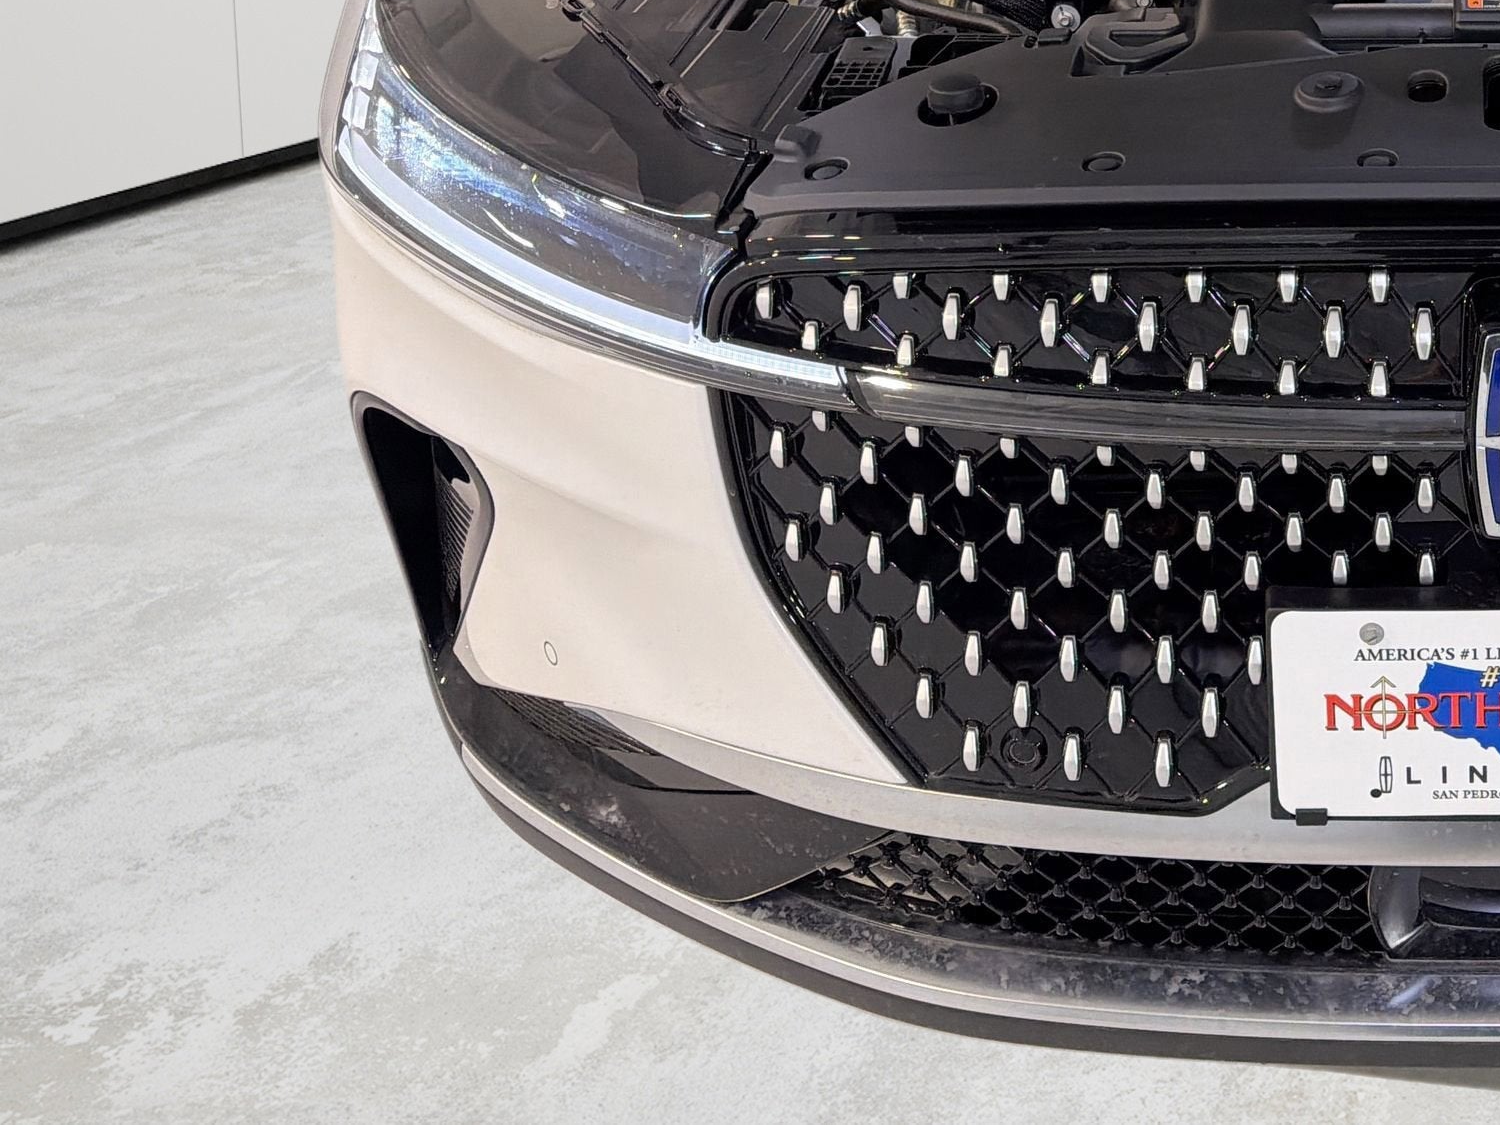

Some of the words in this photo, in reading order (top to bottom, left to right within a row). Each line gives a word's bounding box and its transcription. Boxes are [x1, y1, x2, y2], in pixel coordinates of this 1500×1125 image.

[1354, 646, 1456, 662] AMERICA'S
[1460, 646, 1479, 661] #1
[1432, 789, 1460, 800] SAN
